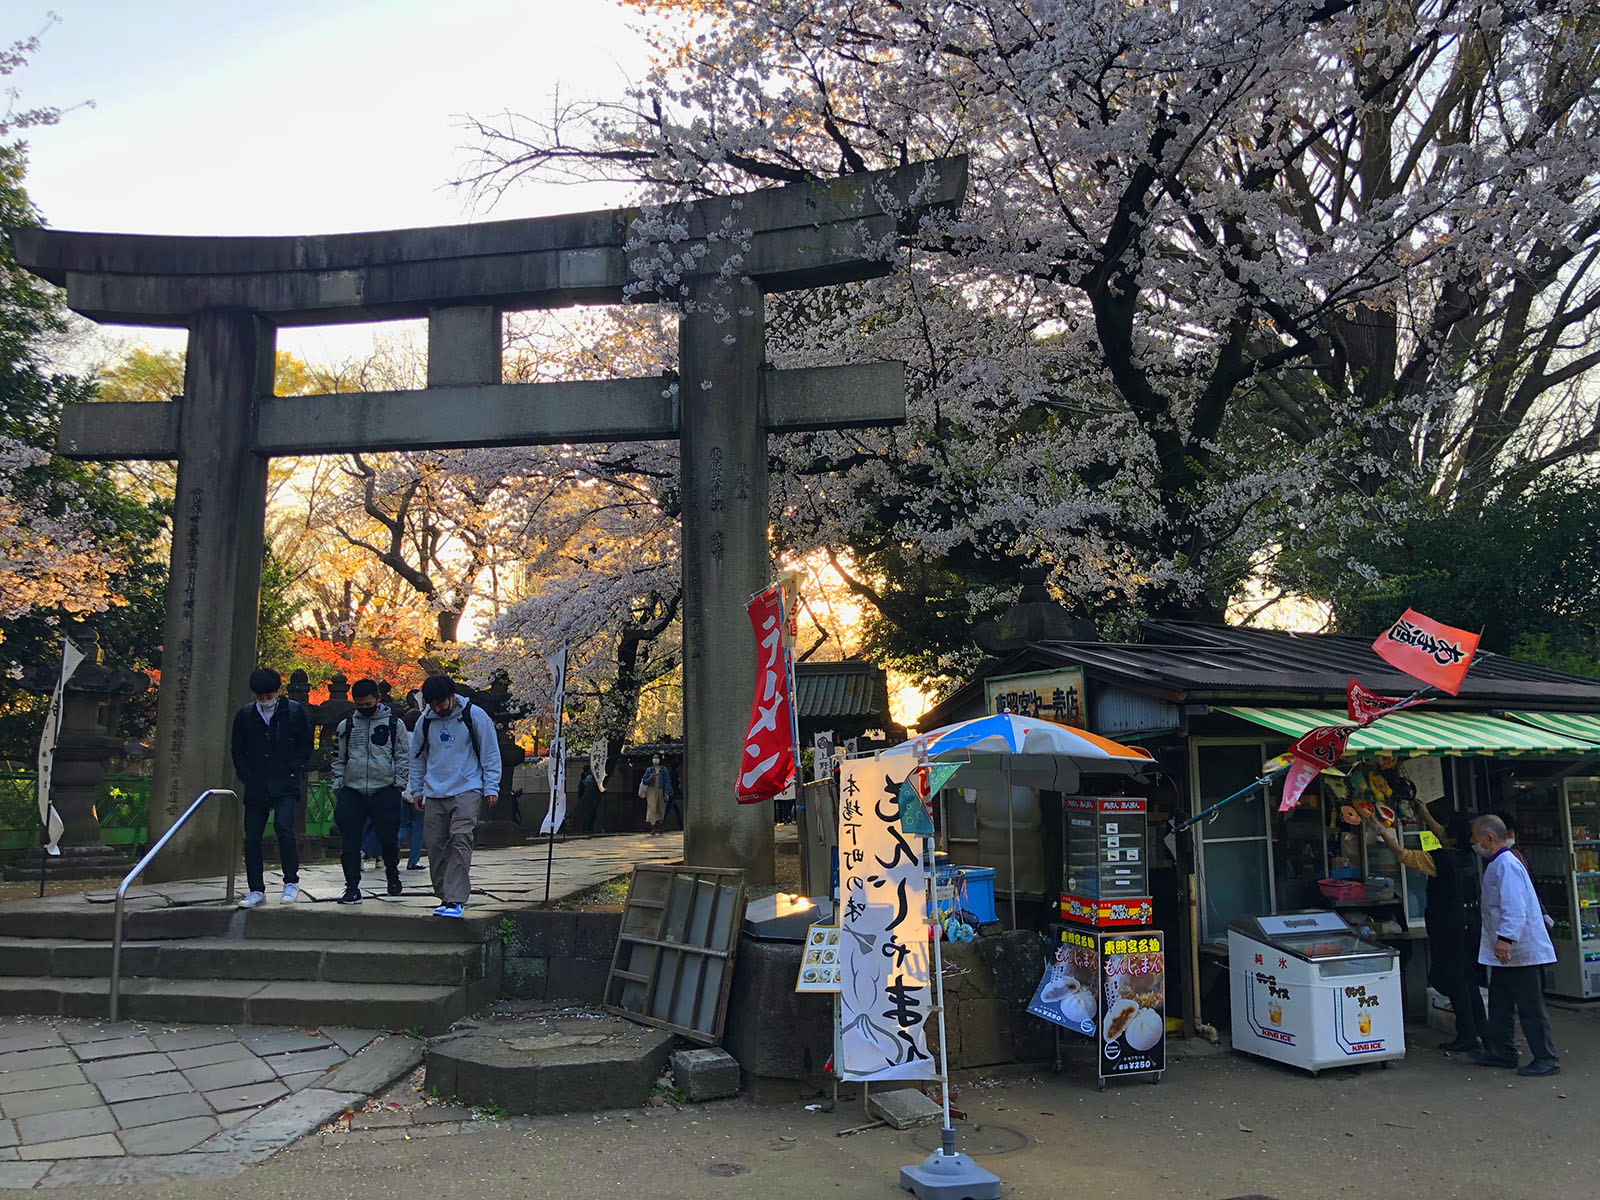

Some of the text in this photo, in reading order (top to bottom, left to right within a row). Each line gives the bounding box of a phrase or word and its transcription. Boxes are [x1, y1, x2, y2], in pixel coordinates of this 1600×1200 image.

[1387, 619, 1466, 664] あま酒
[742, 615, 783, 788] ラーメン
[1103, 801, 1141, 810] 肉まん あんまん
[1104, 938, 1160, 955] 東照宮名物
[1054, 946, 1098, 969] もんじゃまん
[1104, 955, 1162, 977] もんじゃまん
[1358, 995, 1380, 1008] アイス
[1261, 1029, 1292, 1042] KING ICE
[1352, 1044, 1370, 1052] KING
[1129, 1060, 1151, 1070] ¥250
